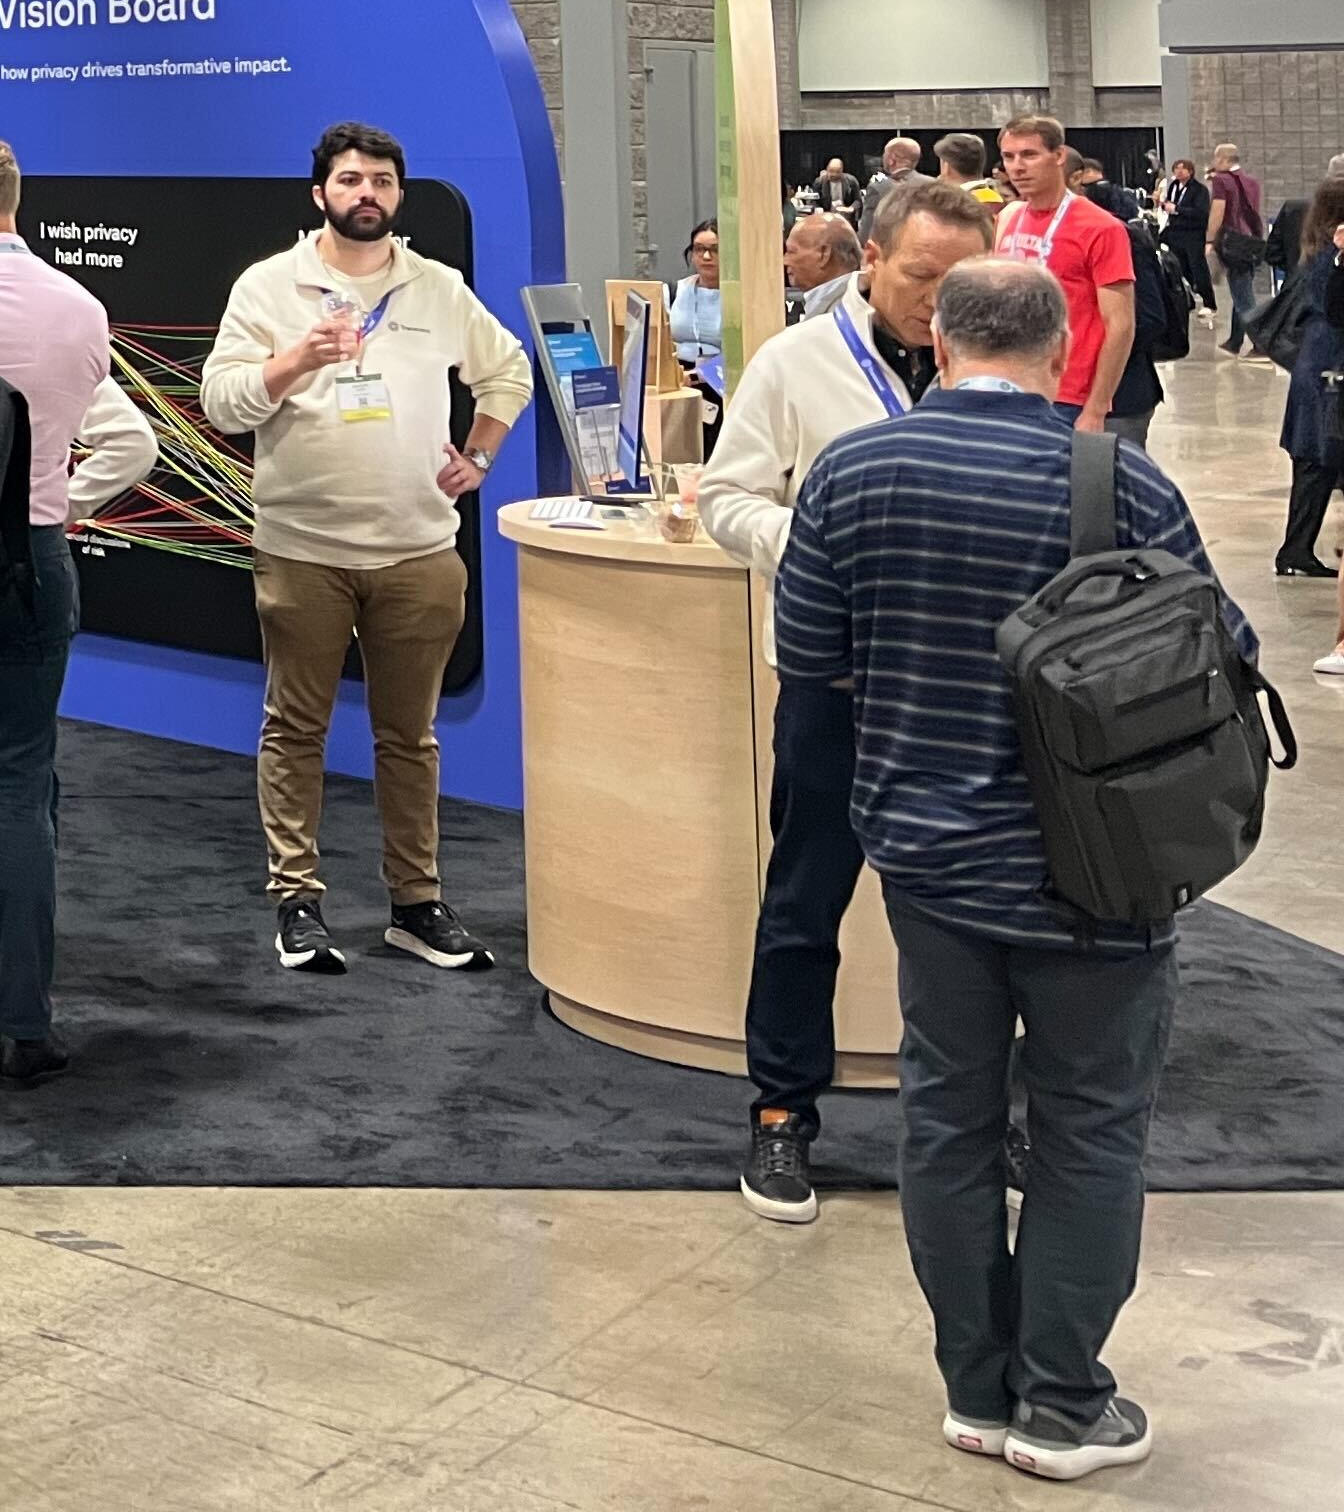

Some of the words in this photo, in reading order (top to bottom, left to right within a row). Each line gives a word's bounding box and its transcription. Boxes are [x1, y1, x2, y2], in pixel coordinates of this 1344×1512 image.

[0, 65, 29, 80] how
[31, 63, 79, 83] privacy
[81, 61, 123, 79] drives
[125, 57, 232, 78] transformative
[234, 56, 292, 76] impact.
[39, 221, 45, 240] I
[47, 221, 81, 240] wish
[83, 222, 138, 246] privacy
[55, 247, 82, 265] had
[85, 253, 124, 268] more
